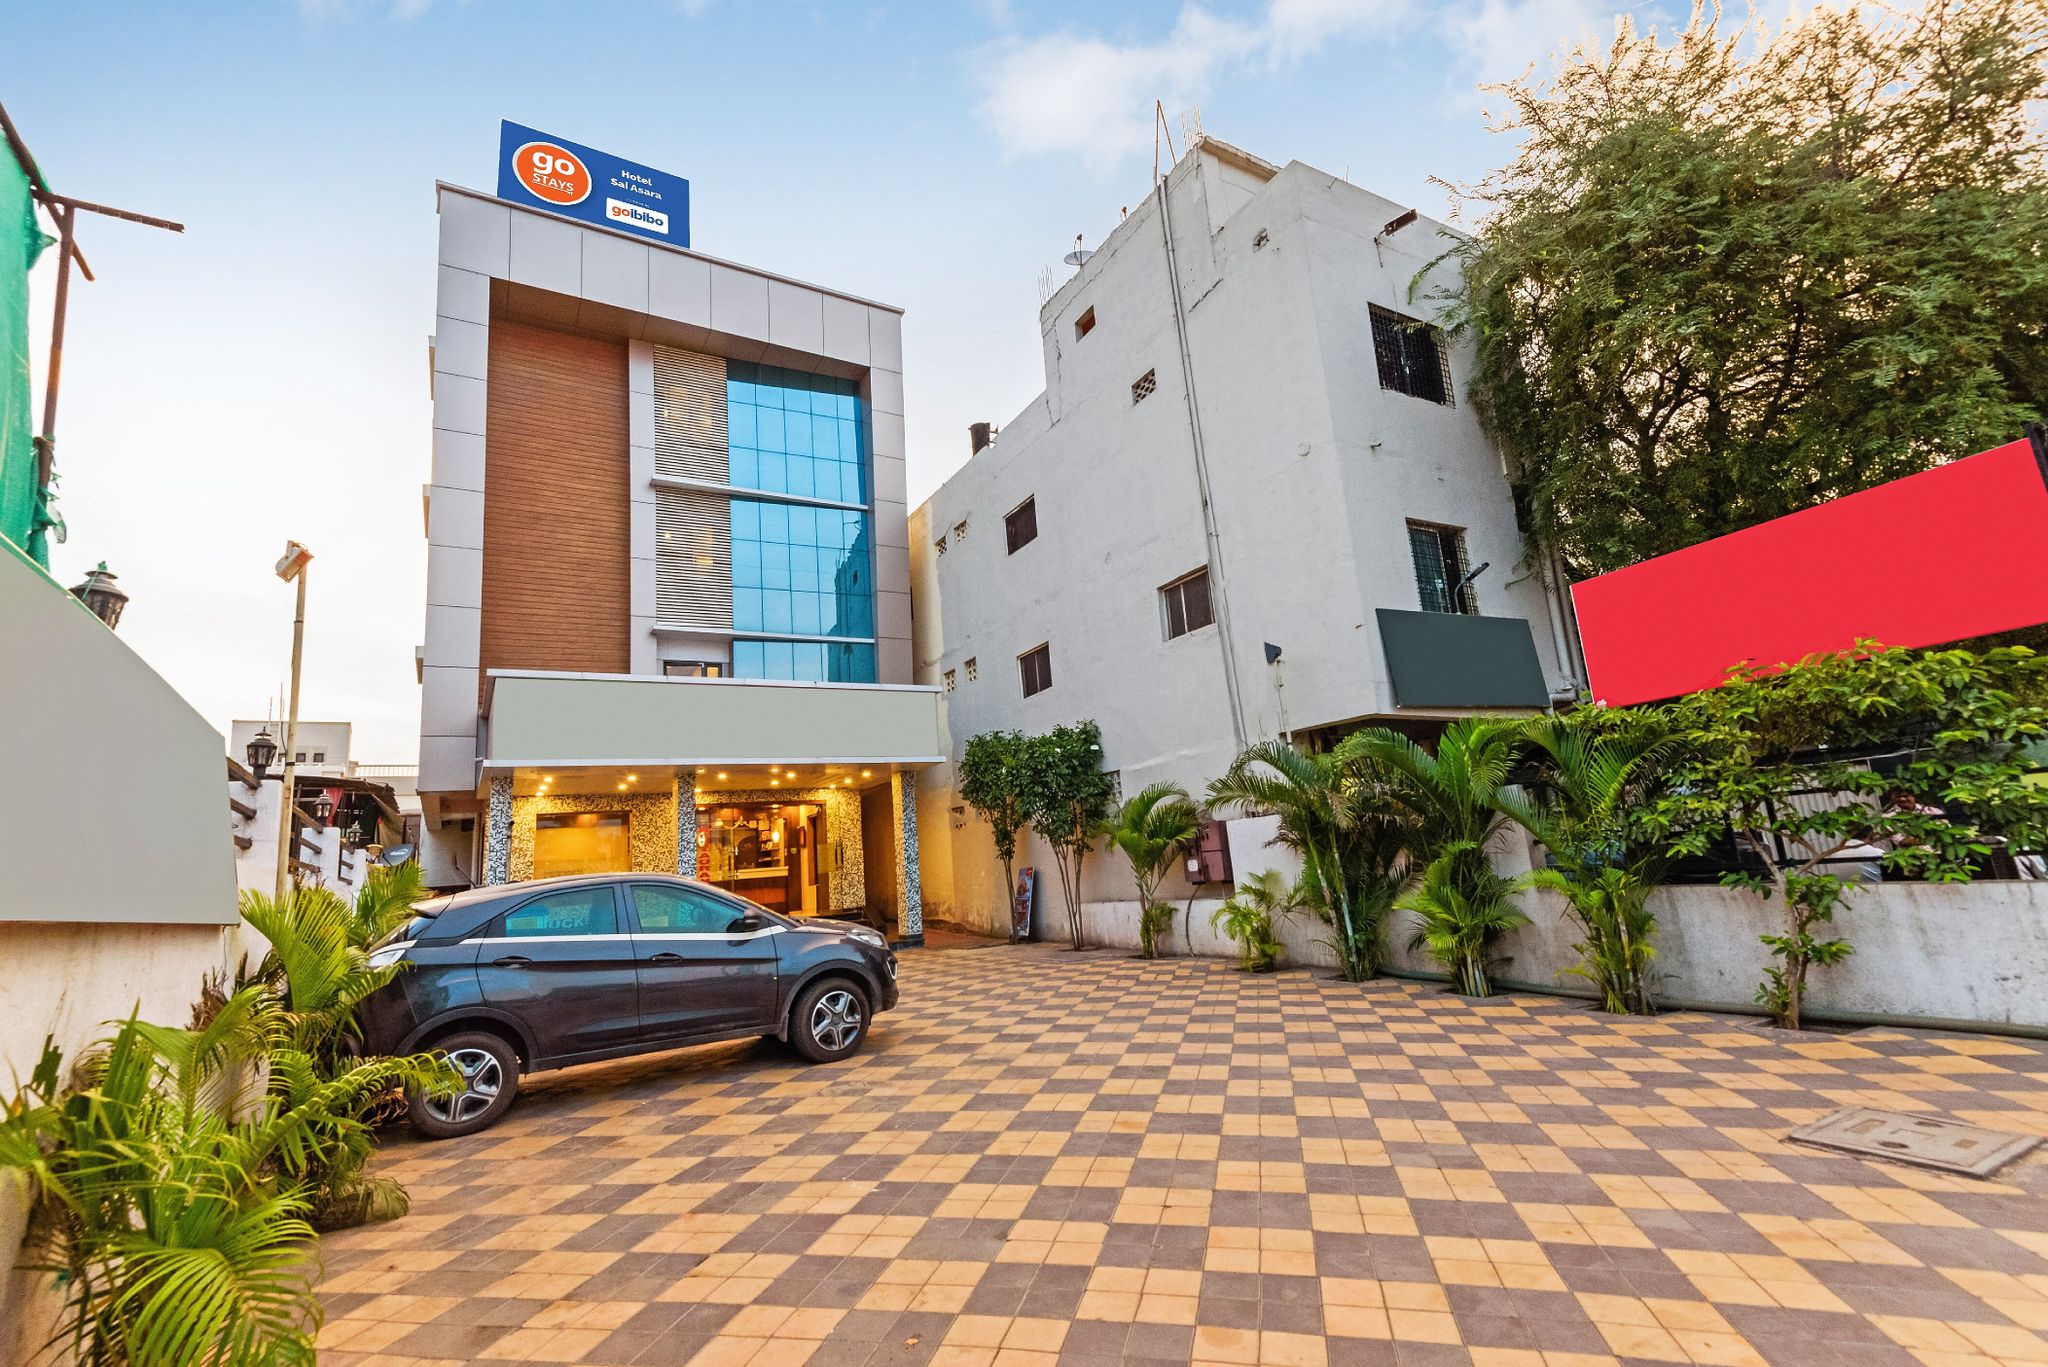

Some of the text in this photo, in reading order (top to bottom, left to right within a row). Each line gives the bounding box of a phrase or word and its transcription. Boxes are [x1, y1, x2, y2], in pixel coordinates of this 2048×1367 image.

[532, 151, 575, 176] go
[532, 172, 575, 193] STAYS
[621, 169, 653, 187] Hotel
[630, 184, 663, 200] Asara
[611, 206, 664, 226] goibibo
